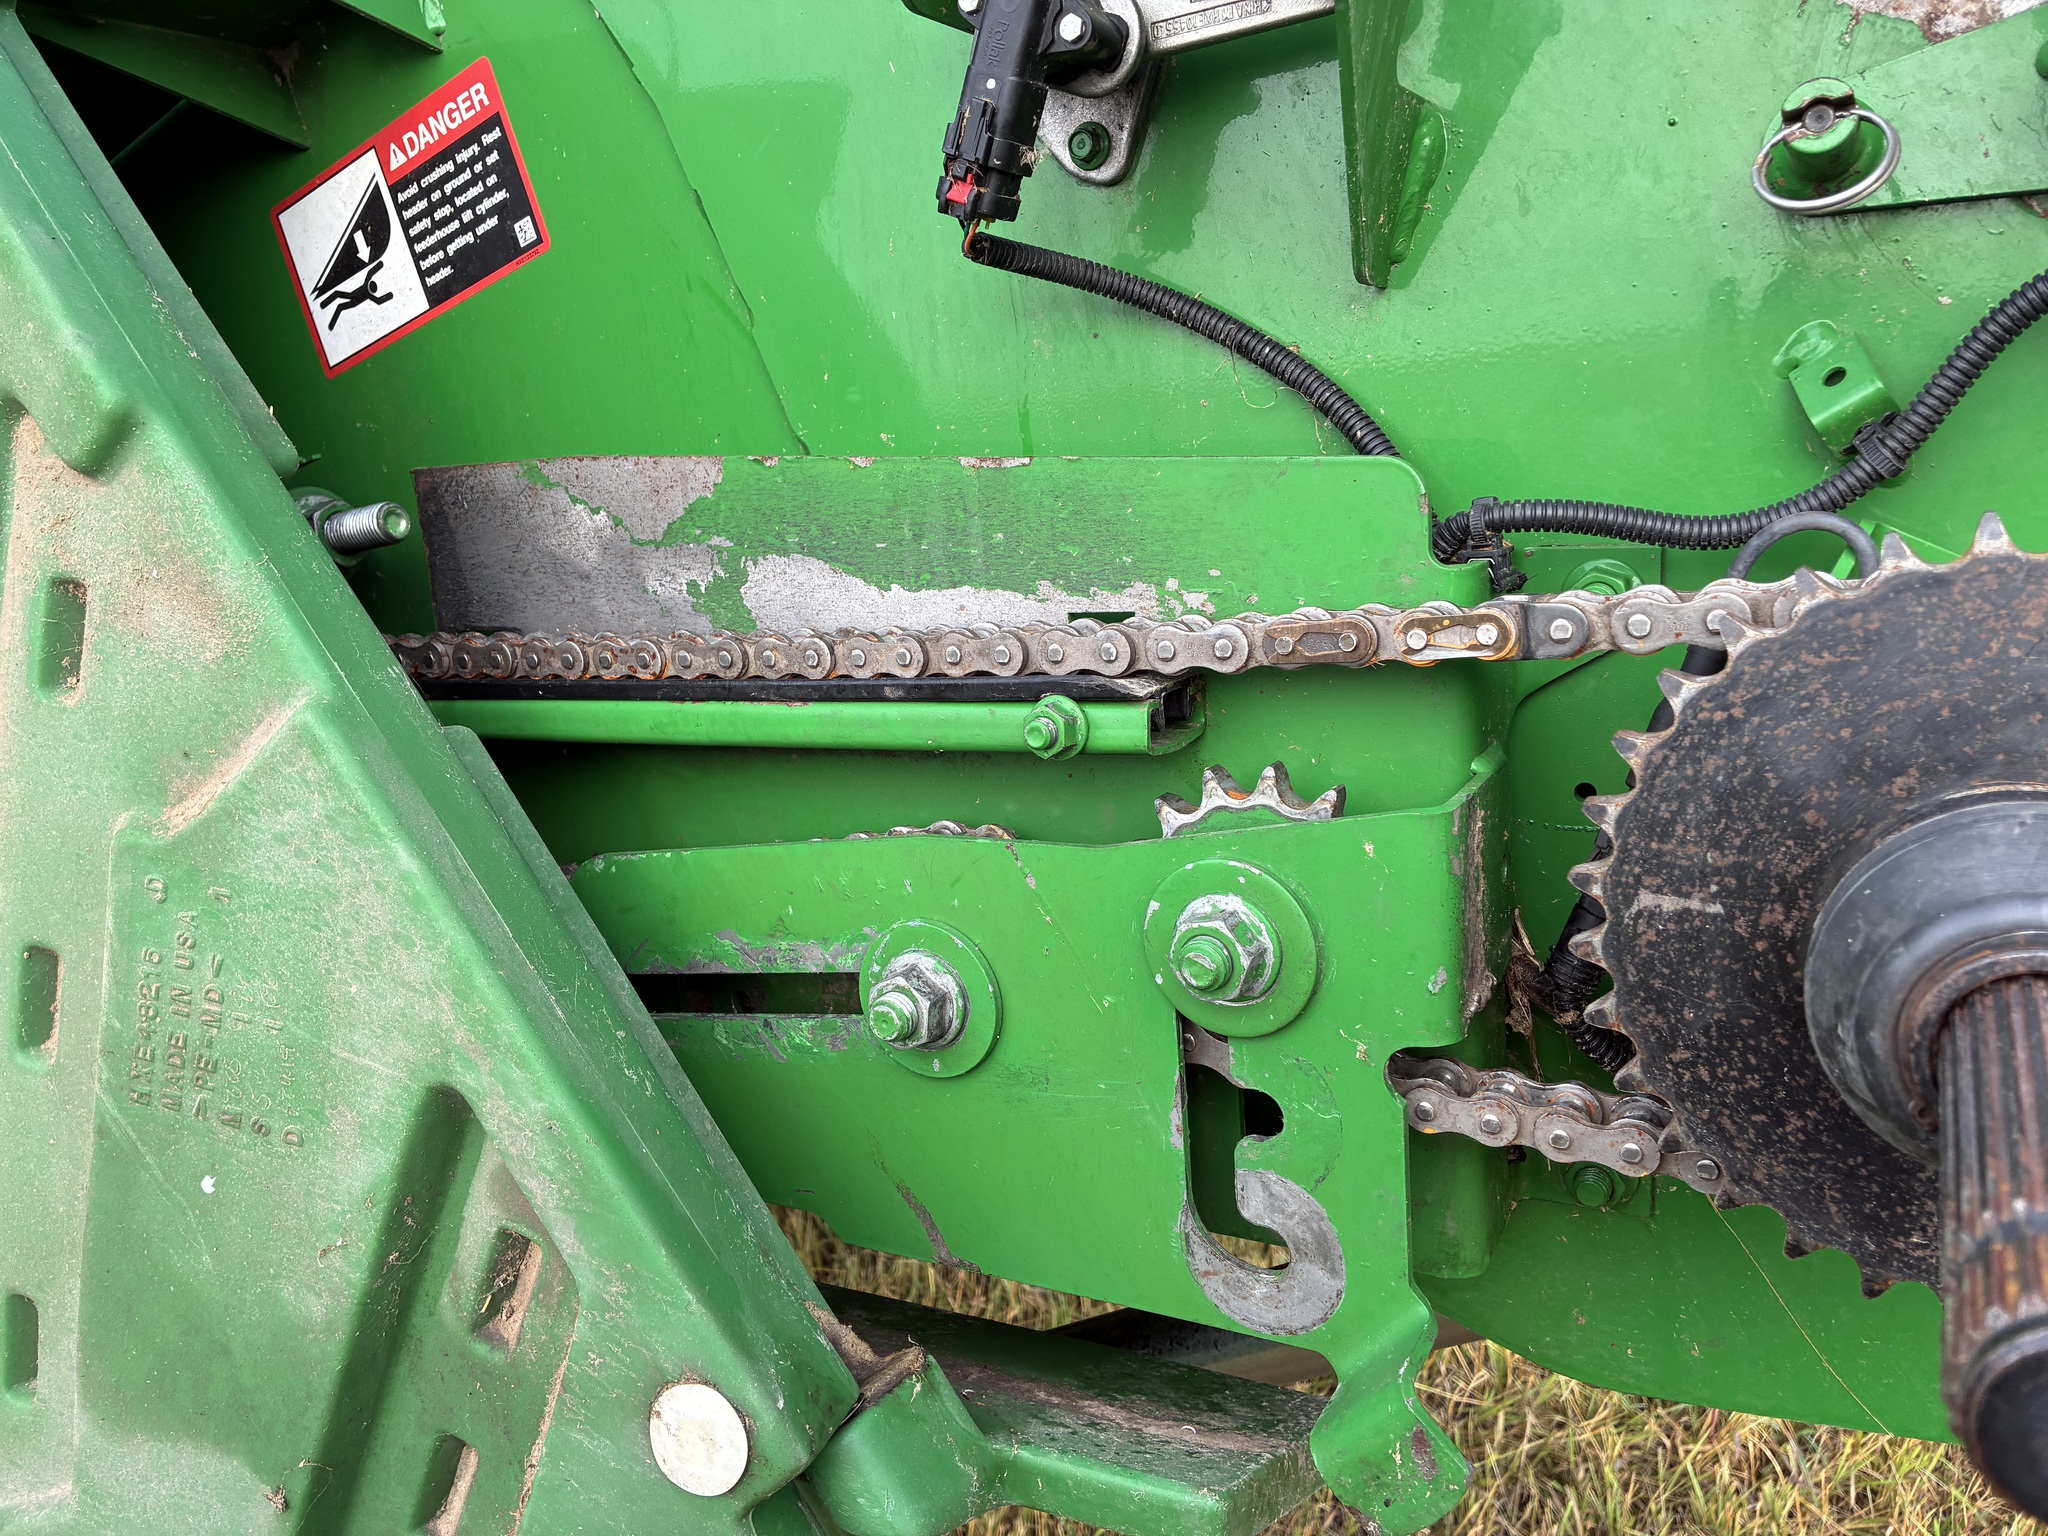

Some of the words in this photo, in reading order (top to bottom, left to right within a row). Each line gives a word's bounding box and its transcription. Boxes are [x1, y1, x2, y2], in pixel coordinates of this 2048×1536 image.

[987, 20, 1010, 67] Pollak
[402, 82, 490, 158] DANGER
[398, 182, 419, 204] Avoid
[421, 160, 454, 187] crushing
[455, 143, 480, 164] injury.
[481, 126, 502, 146] Rest
[402, 198, 428, 220] header
[431, 190, 442, 202] on
[444, 167, 472, 195] ground
[474, 161, 483, 173] or
[486, 150, 499, 165] set
[409, 217, 431, 237] safety
[434, 204, 454, 221] stop,
[454, 181, 484, 207] located
[486, 174, 497, 186] on
[414, 219, 460, 253] feederhouse
[461, 209, 474, 223] lift
[476, 189, 509, 215] cylinder,
[420, 250, 444, 270] before
[447, 232, 474, 256] getting
[476, 215, 498, 235] under
[425, 265, 454, 287] header.
[173, 909, 199, 971] USA
[169, 983, 193, 1019] IN
[158, 1029, 189, 1113] MADE
[282, 1124, 305, 1148] D
